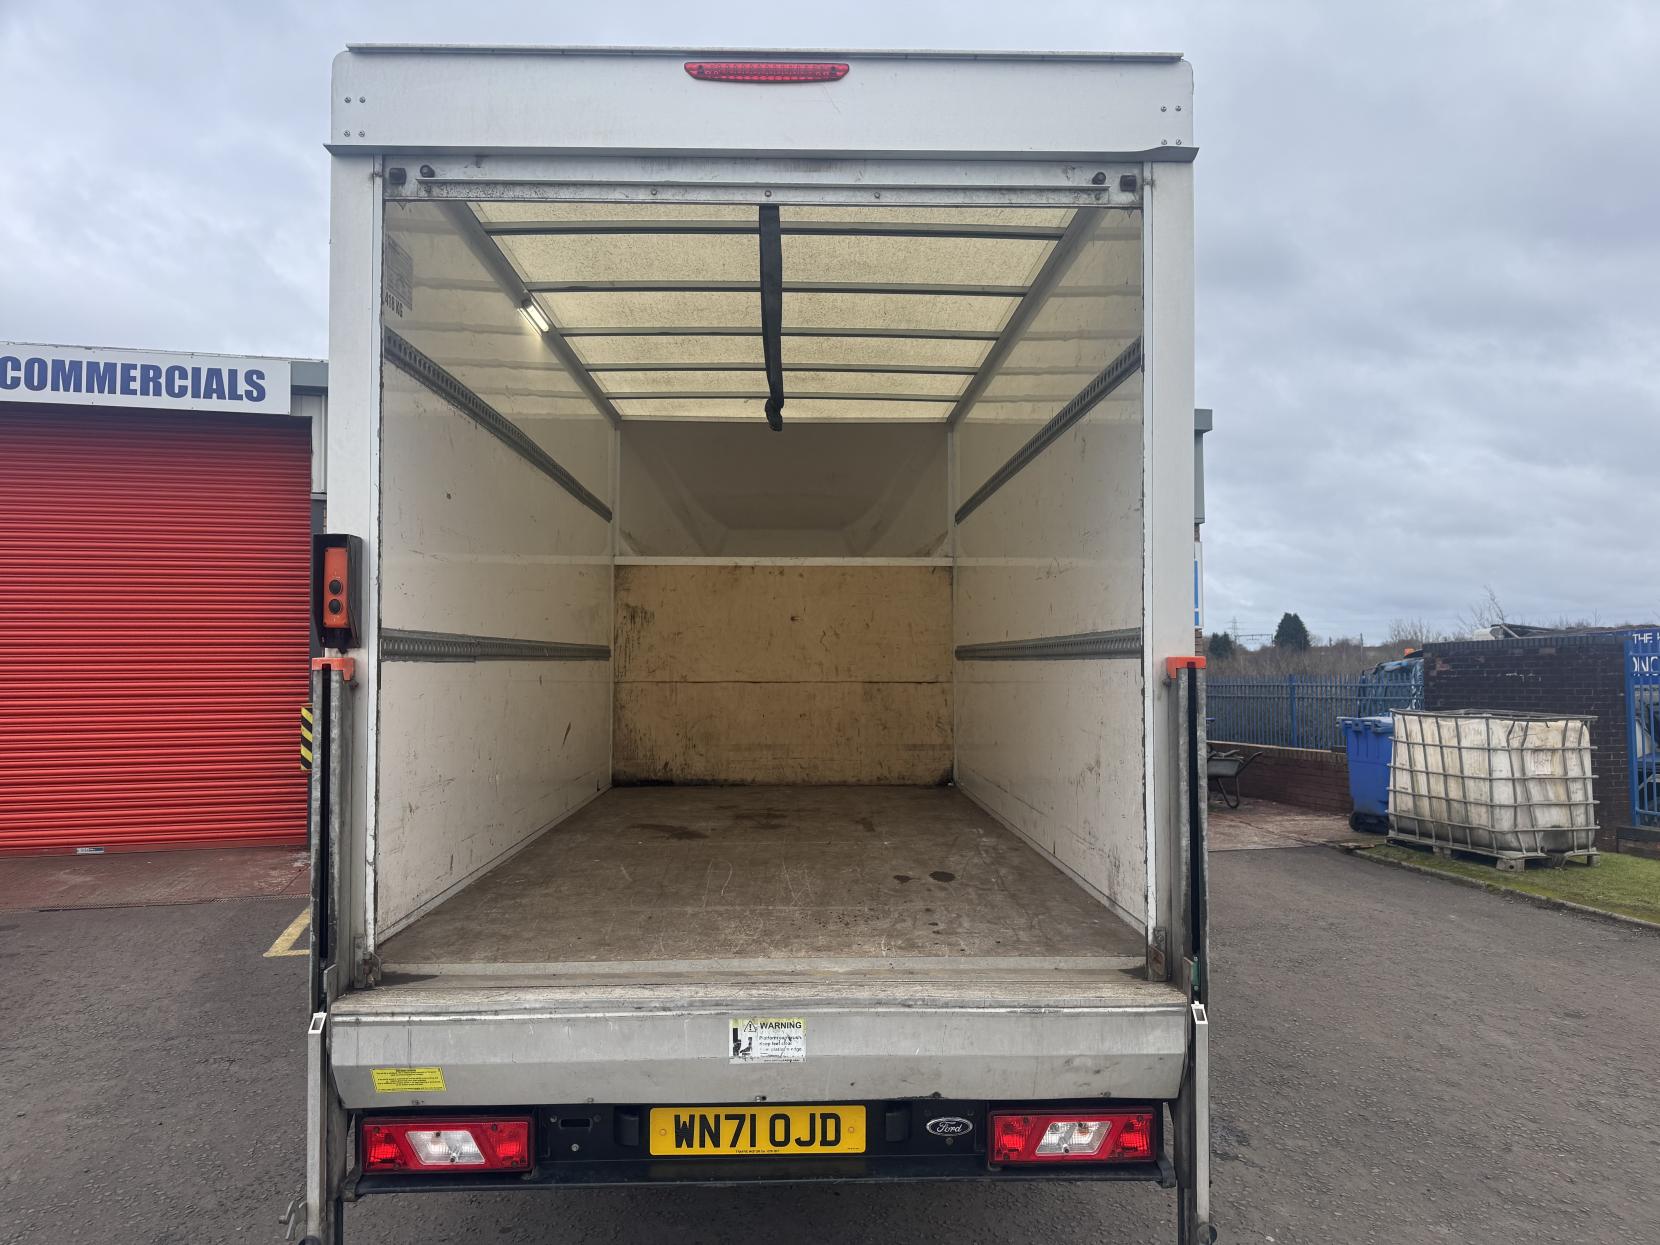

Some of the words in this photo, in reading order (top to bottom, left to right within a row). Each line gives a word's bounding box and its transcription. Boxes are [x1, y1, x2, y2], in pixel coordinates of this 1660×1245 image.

[0, 356, 266, 402] COMMERCIALS
[674, 1114, 756, 1148] WN71
[769, 1113, 841, 1147] OJD
[936, 1121, 963, 1133] Ford
